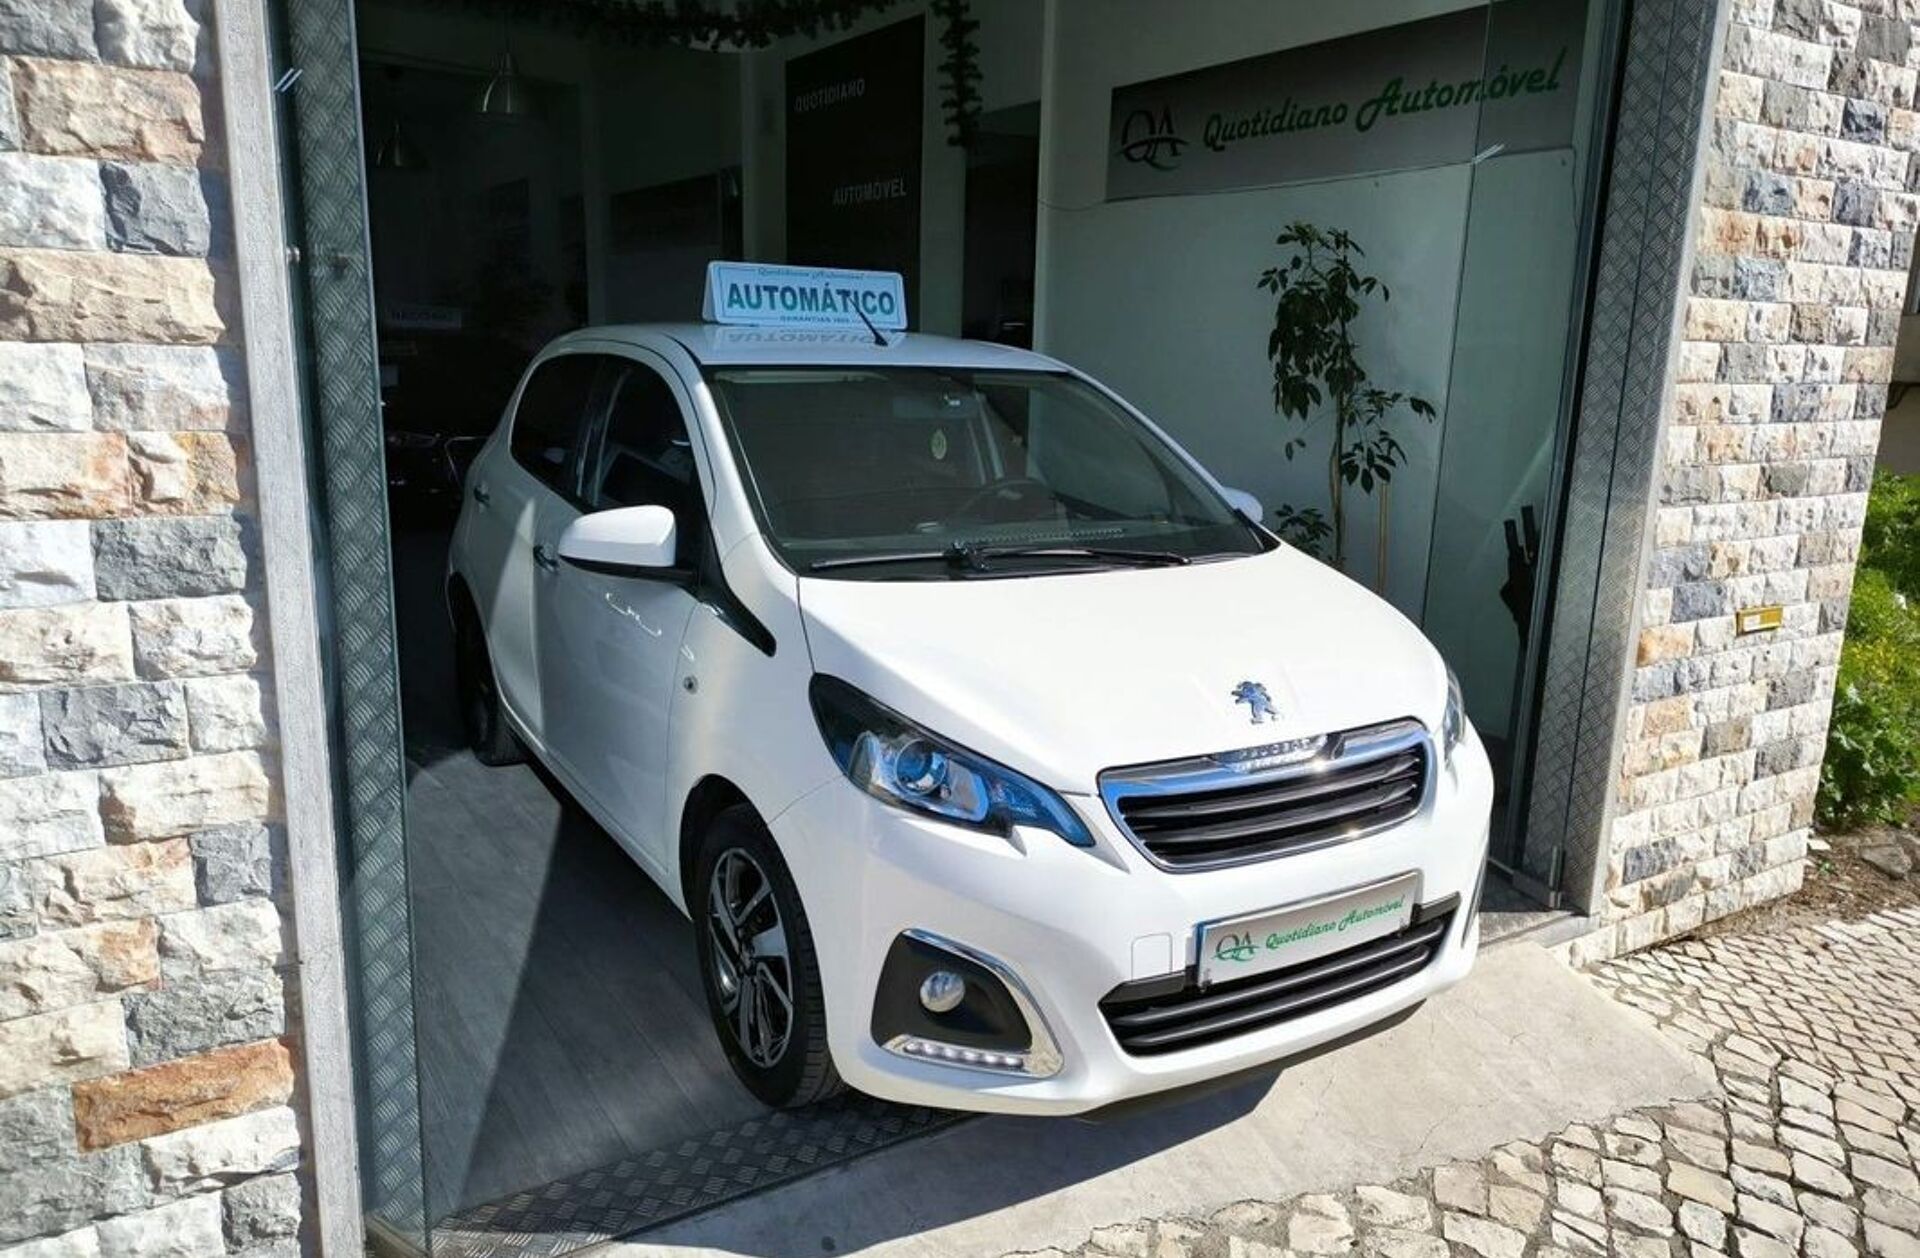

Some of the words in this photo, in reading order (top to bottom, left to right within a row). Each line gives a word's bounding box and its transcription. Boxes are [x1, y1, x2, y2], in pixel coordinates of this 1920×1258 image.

[794, 78, 865, 112] QUOTIDIANO
[1203, 97, 1348, 152] Quotidiano
[1355, 46, 1568, 132] Automóvel
[727, 282, 895, 315] AUTOMÁTICO
[1265, 921, 1336, 949] Quotidiano
